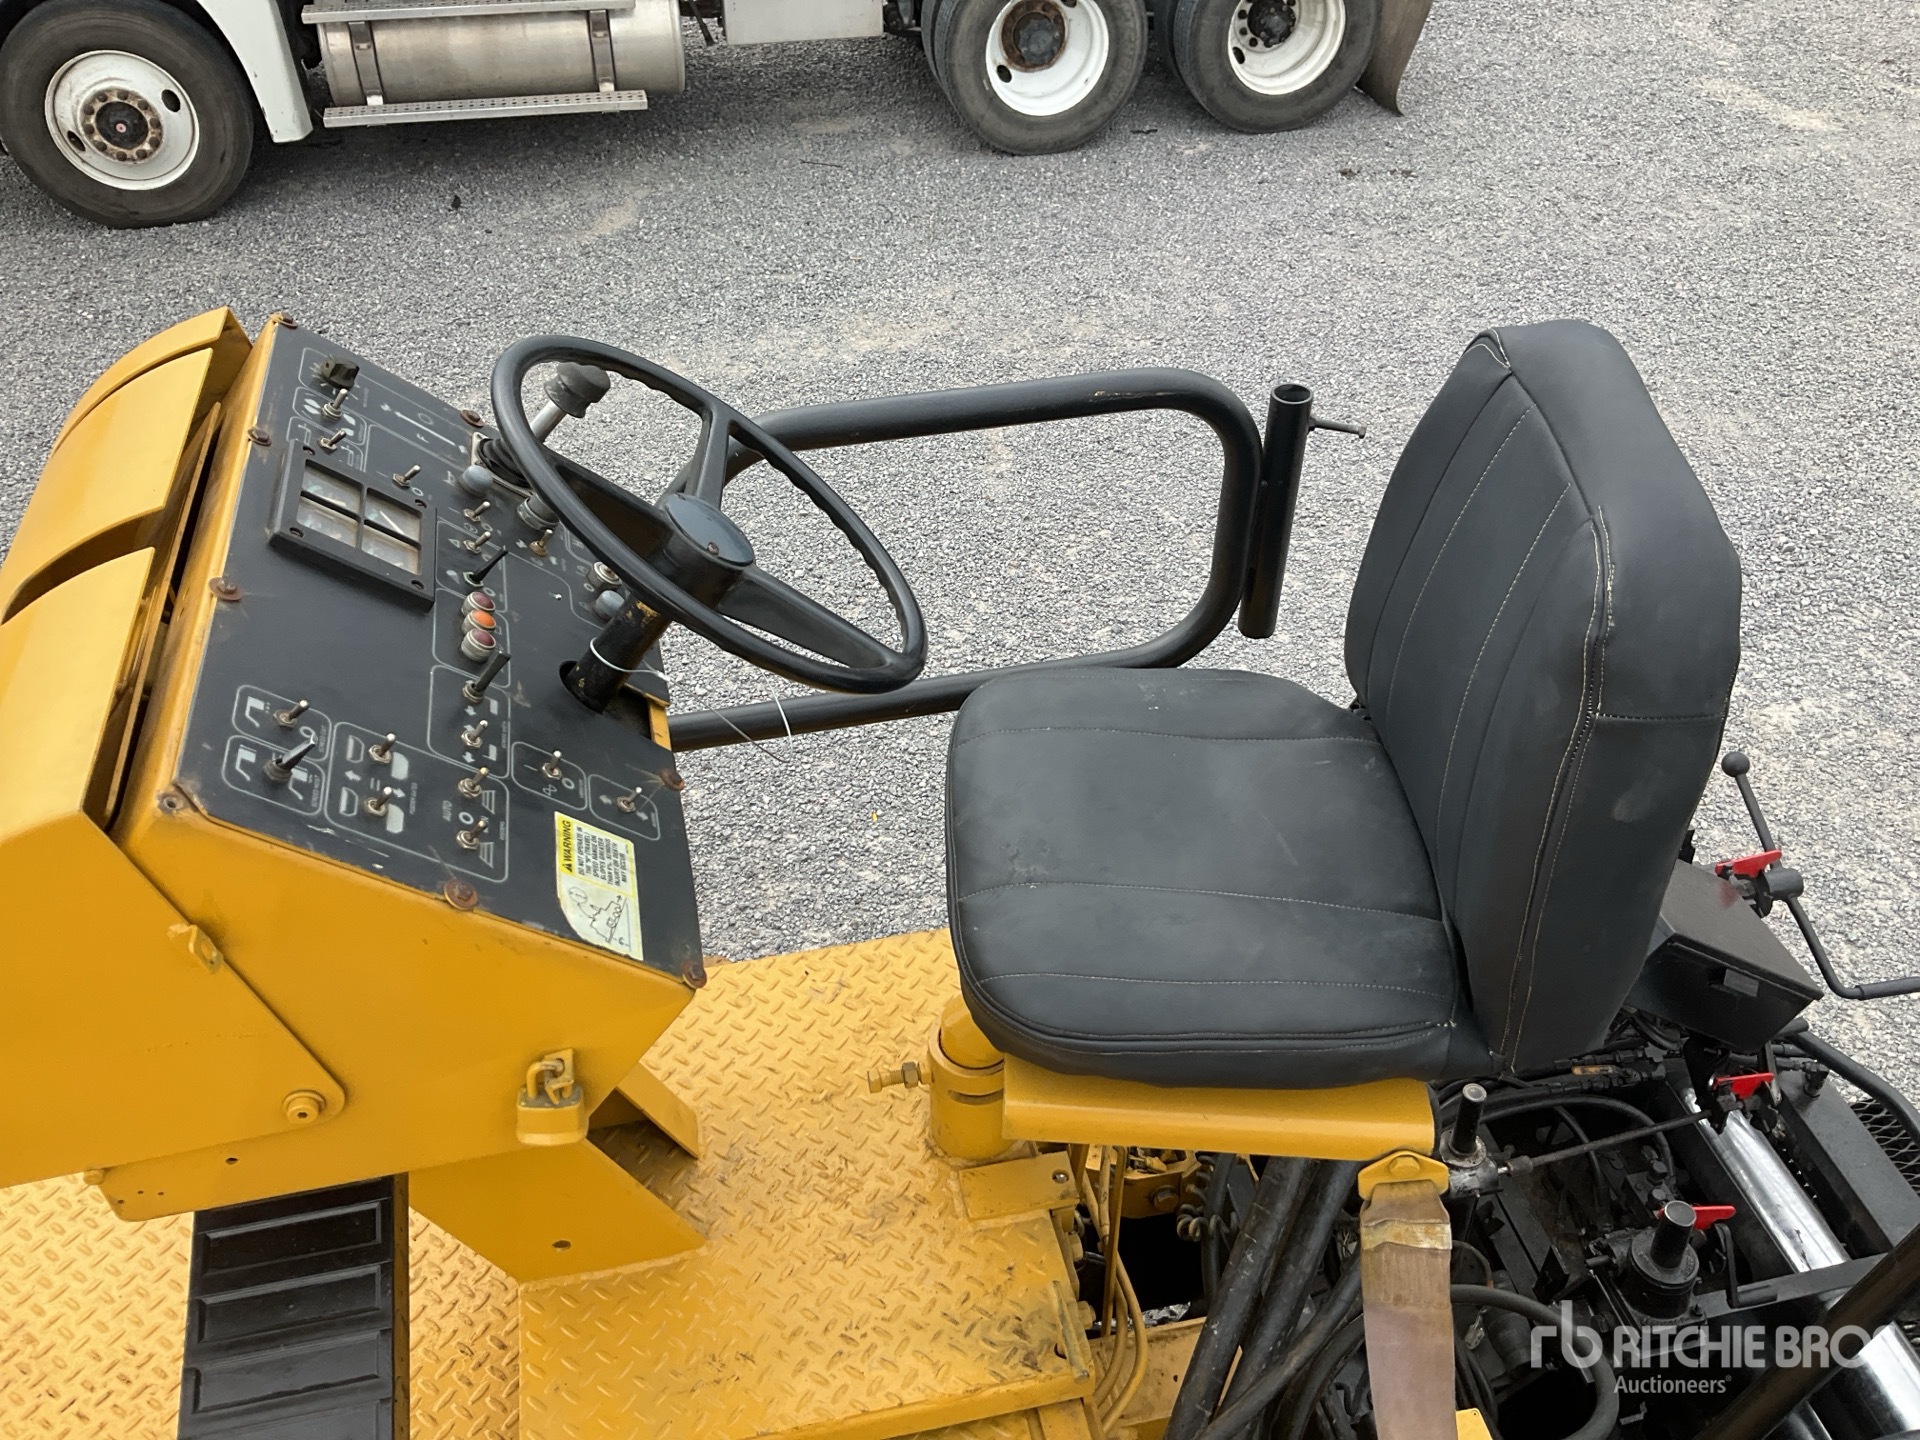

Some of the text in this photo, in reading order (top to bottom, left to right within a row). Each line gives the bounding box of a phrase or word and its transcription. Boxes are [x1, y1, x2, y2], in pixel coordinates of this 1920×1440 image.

[442, 800, 452, 821] AUTO
[562, 820, 572, 862] WARNING
[591, 835, 597, 843] ON
[613, 859, 619, 867] OR
[578, 867, 585, 875] DO
